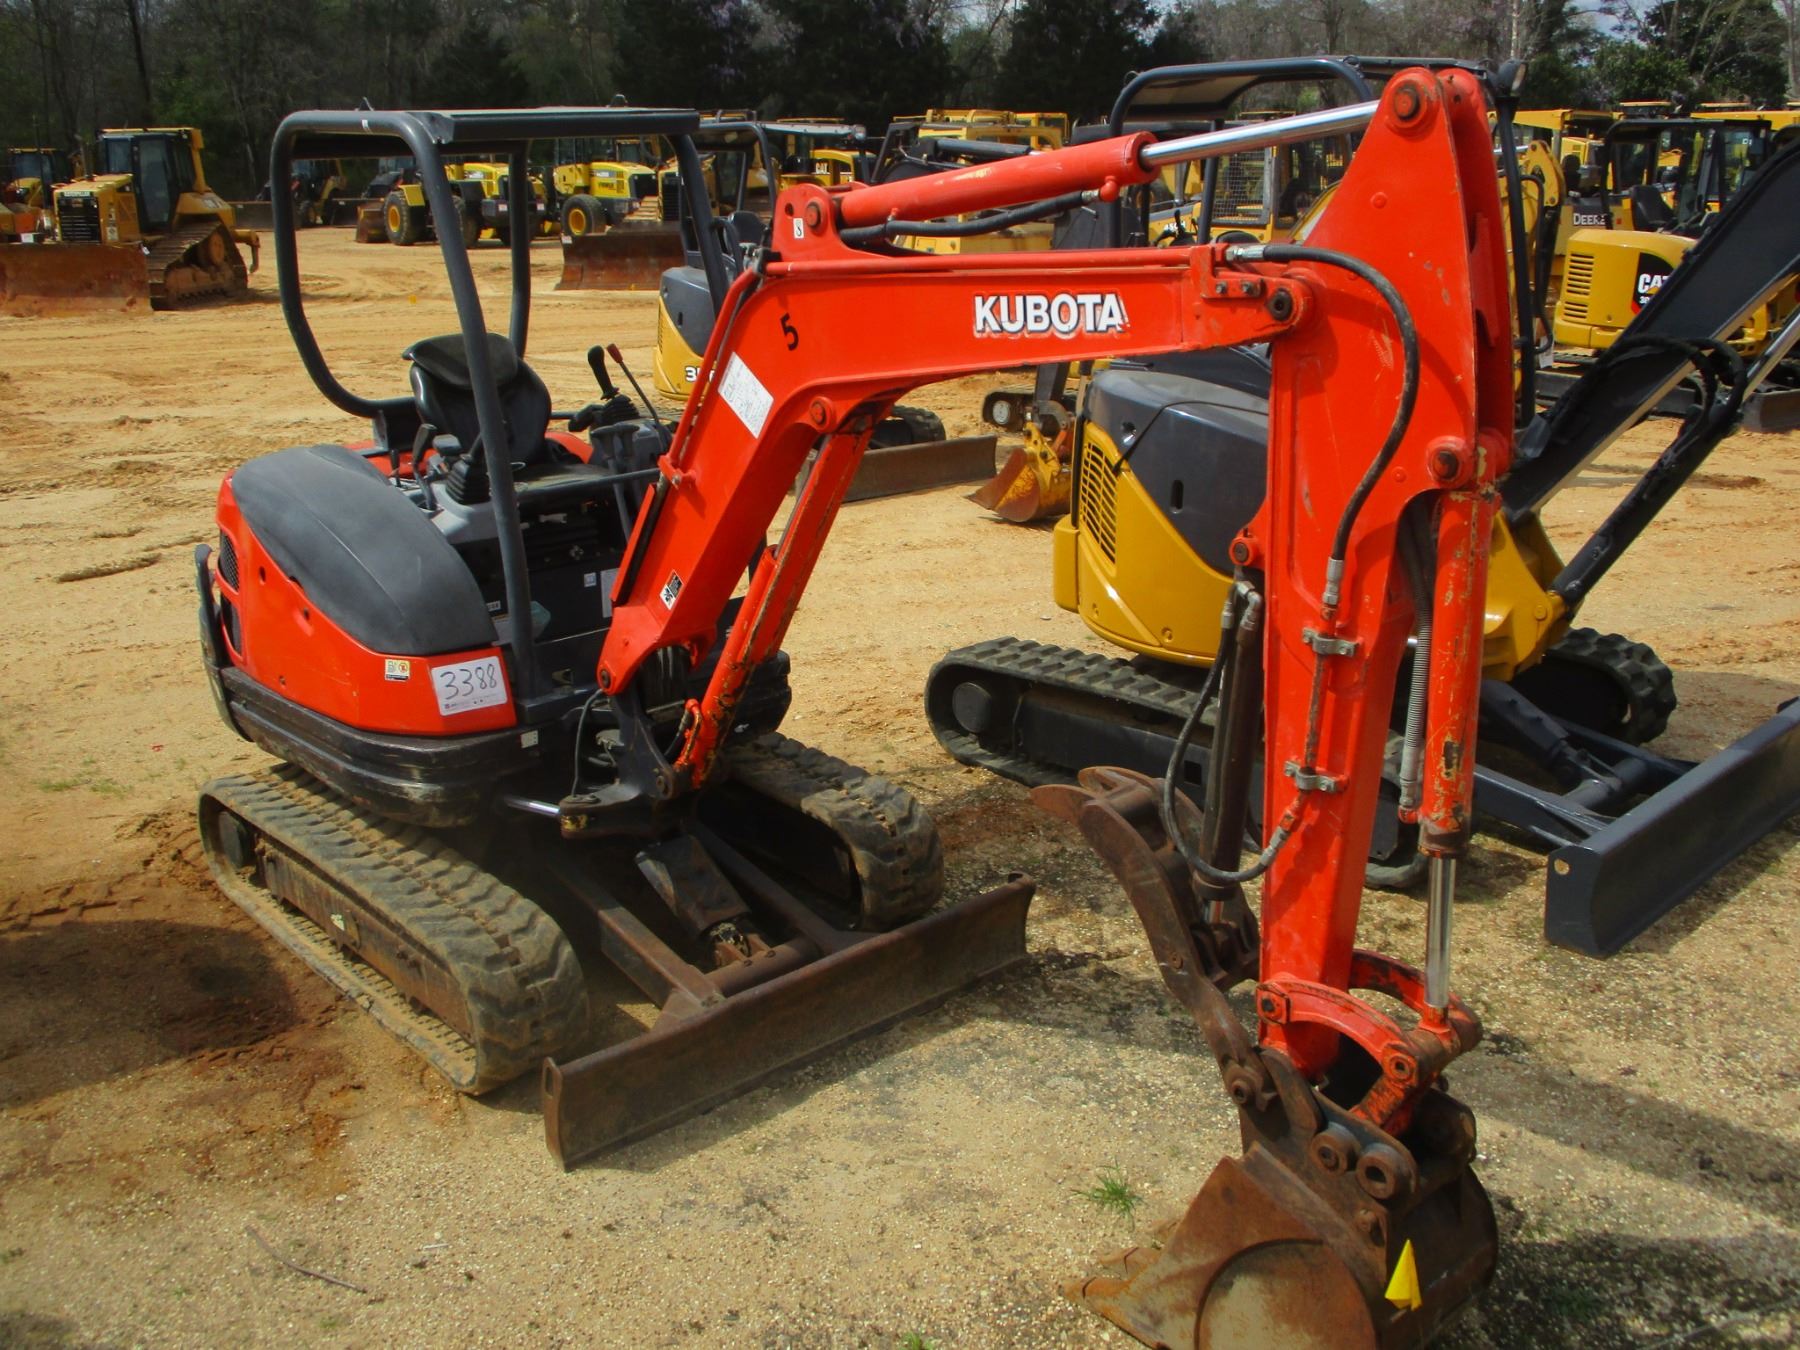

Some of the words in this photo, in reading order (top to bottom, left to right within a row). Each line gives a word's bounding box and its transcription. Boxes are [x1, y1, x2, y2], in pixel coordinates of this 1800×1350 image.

[815, 162, 828, 175] CAT
[779, 312, 800, 352] 5
[973, 292, 1125, 334] KUBOTA
[439, 663, 498, 701] 3388
